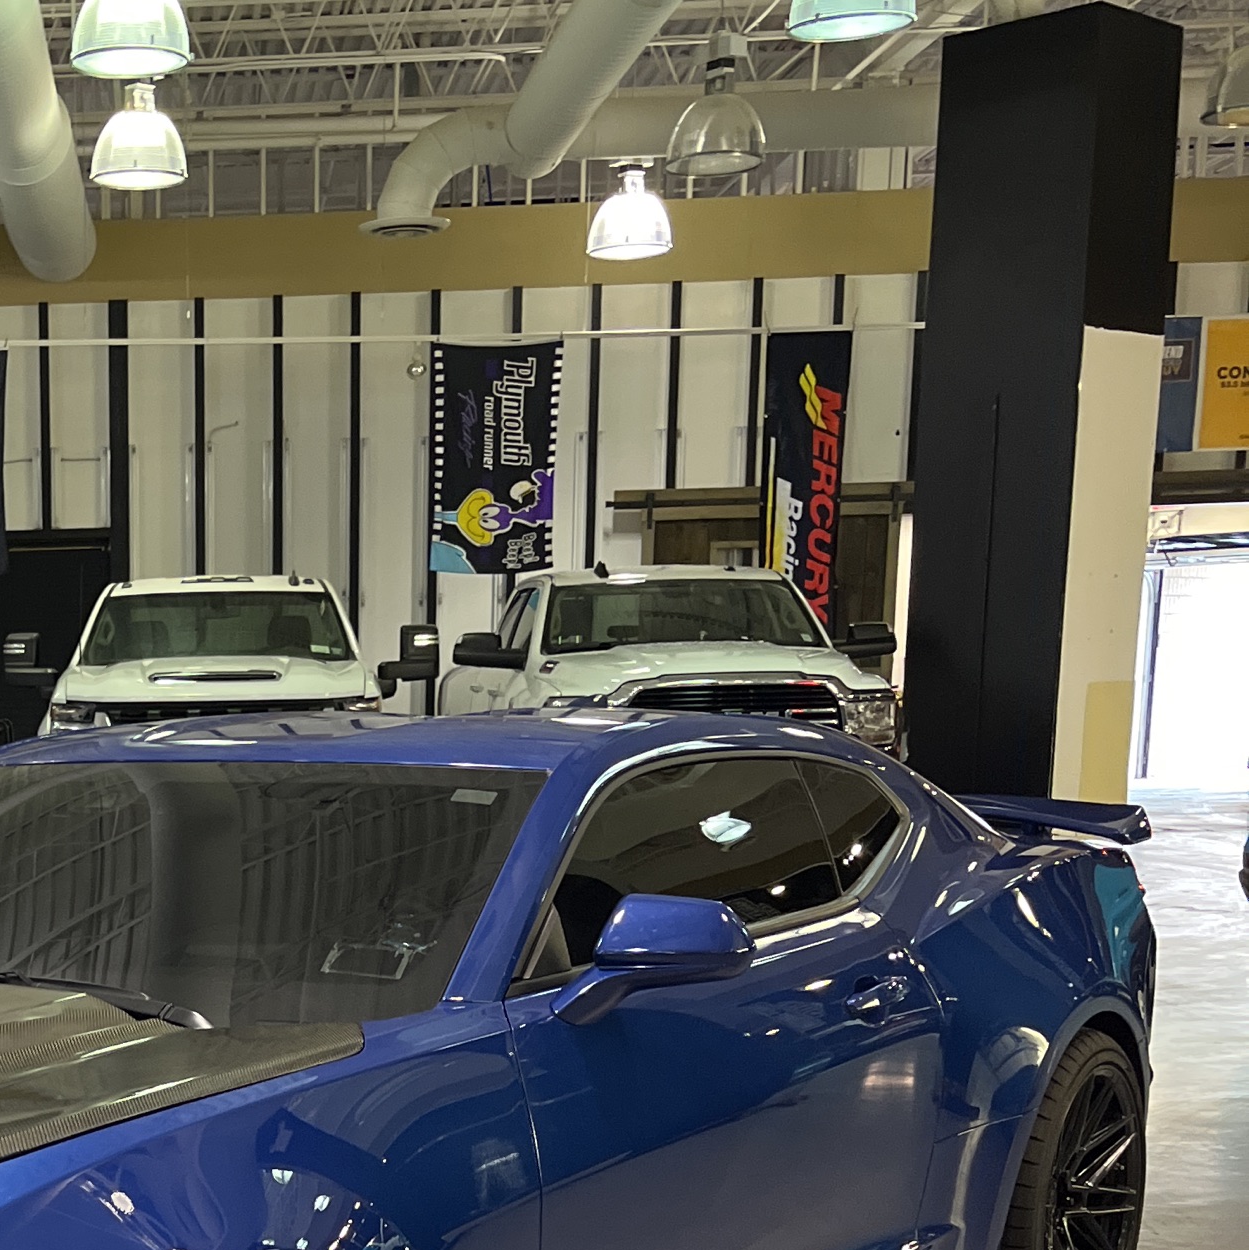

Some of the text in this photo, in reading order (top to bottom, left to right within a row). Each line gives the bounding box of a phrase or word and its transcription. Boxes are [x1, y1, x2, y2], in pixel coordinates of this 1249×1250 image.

[482, 396, 497, 471] road runner
[492, 356, 537, 467] Plymouth
[780, 497, 803, 583] Racin
[804, 384, 842, 625] MERCURY
